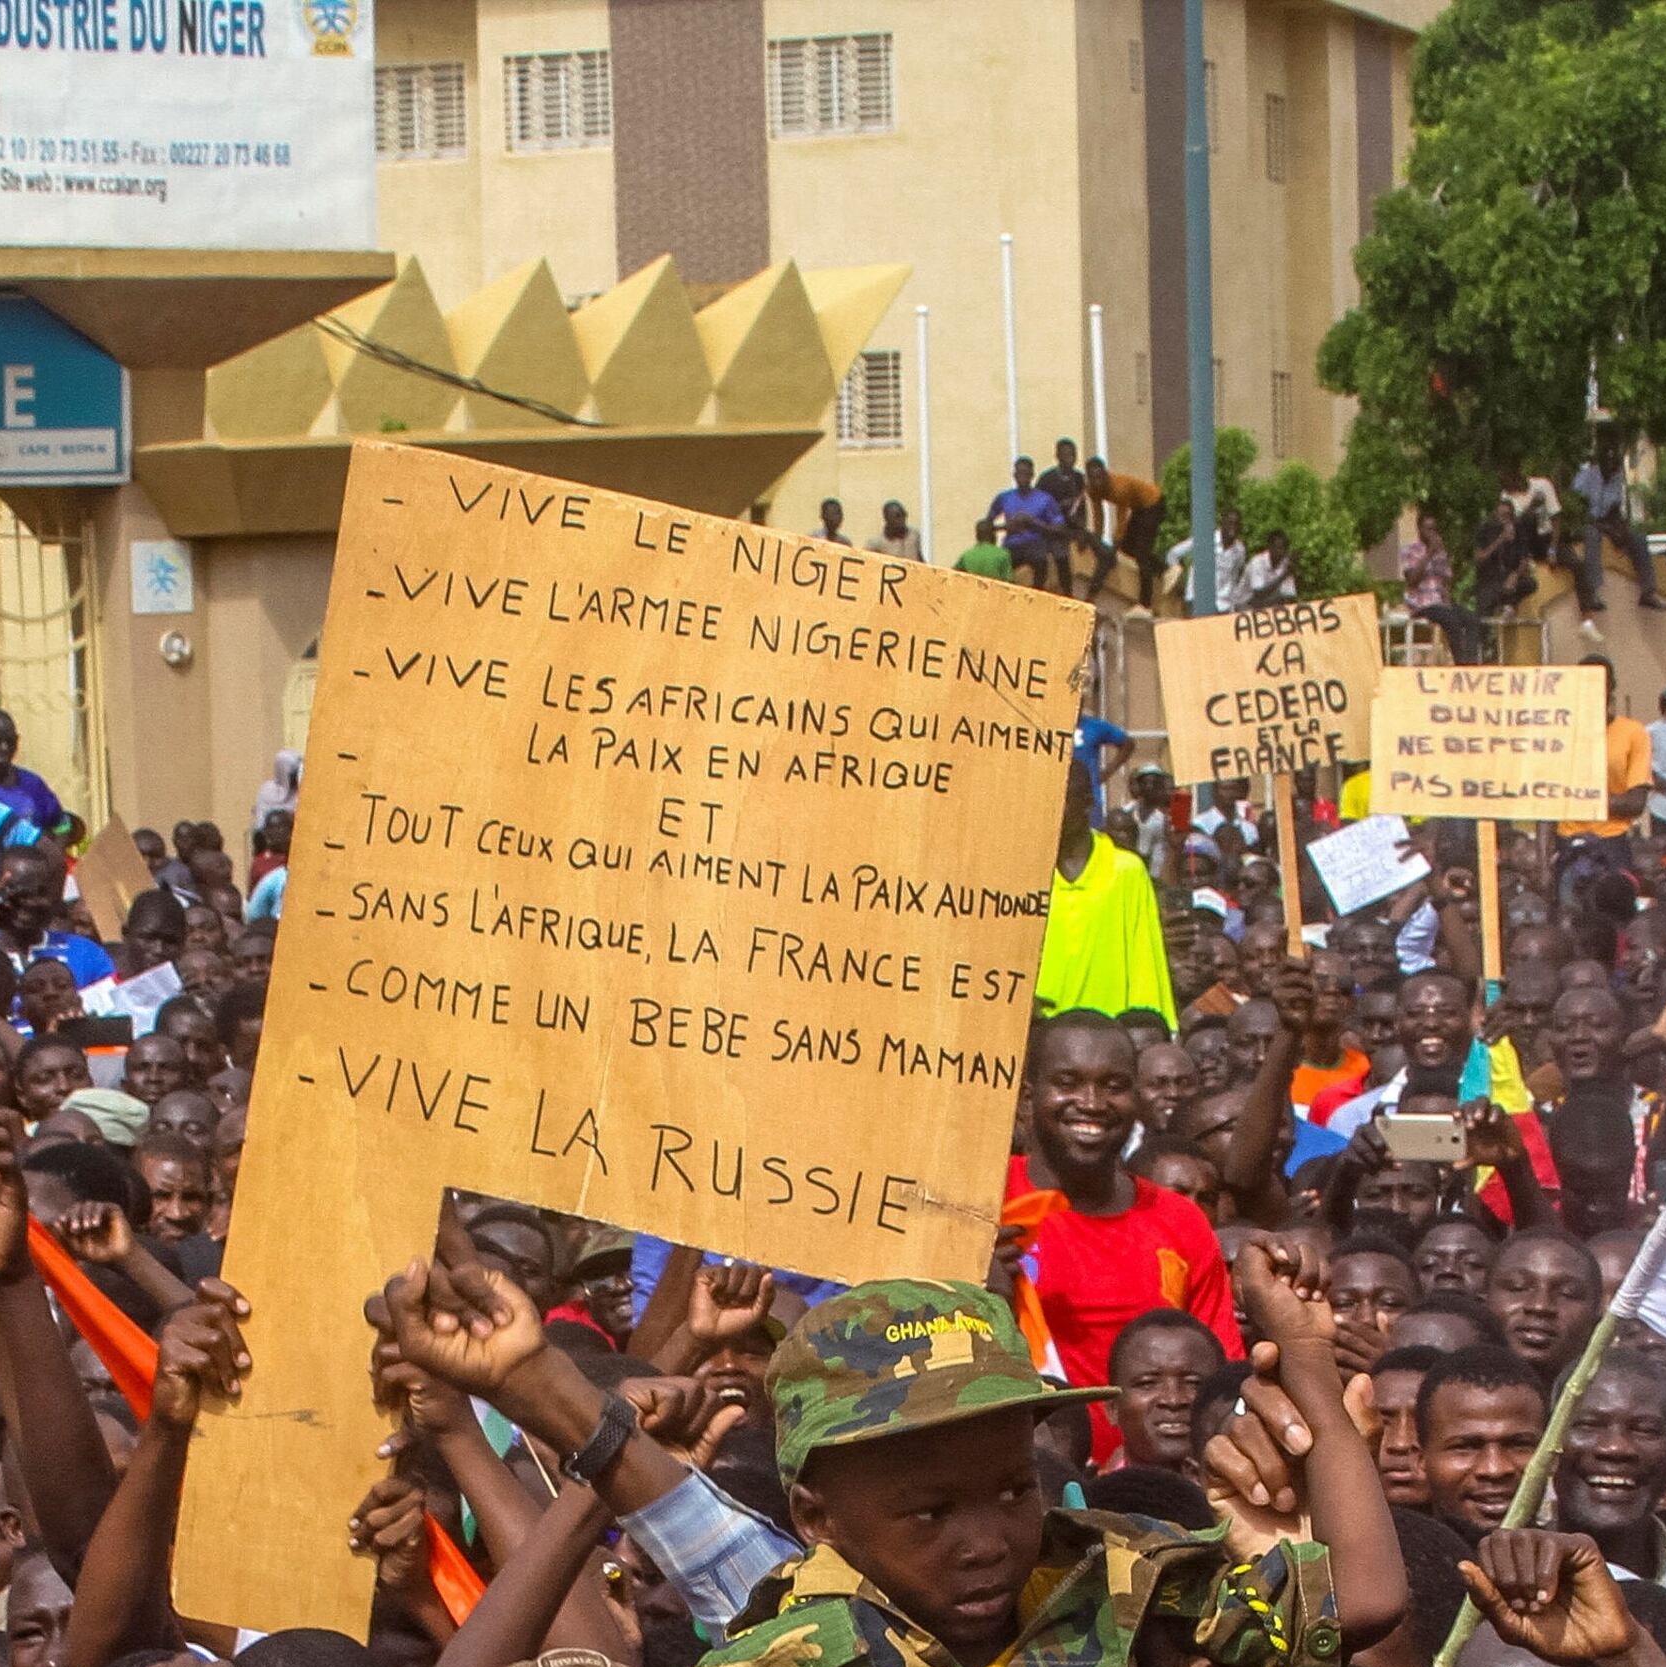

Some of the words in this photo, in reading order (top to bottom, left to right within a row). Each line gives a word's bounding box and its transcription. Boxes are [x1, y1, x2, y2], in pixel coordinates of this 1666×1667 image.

[130, 0, 166, 51] DU
[179, 0, 266, 58] NIGER
[39, 138, 56, 161] 20
[60, 139, 78, 162] 73
[234, 142, 251, 166] 73
[449, 475, 591, 531] VIVE
[634, 511, 692, 555] LE
[732, 535, 908, 608] NIGER
[548, 580, 723, 641] L'ARMEE
[749, 614, 1049, 700] NIGERIENNE
[1234, 601, 1341, 642] ABBAS
[542, 664, 617, 714] LES
[626, 684, 852, 738] AFRICAINS
[869, 706, 939, 742] QUI
[950, 714, 1073, 763] AIMENT
[1206, 679, 1348, 727] CEDEAO
[1257, 724, 1282, 745] ET
[1293, 718, 1321, 737] LA
[528, 722, 569, 766] LA
[590, 726, 683, 775] PAIX
[708, 744, 761, 780] EN
[784, 751, 953, 793] AFRIQUE
[1397, 735, 1435, 756] NE
[1443, 736, 1565, 755] DEPEND
[1389, 770, 1453, 799] PAS
[658, 797, 724, 845] ET
[361, 792, 464, 848] TOUT
[477, 819, 554, 863] CEUX
[568, 837, 633, 871] QUI
[649, 849, 787, 897] AIMENT
[801, 863, 840, 904] LA
[852, 864, 929, 915] PAIX
[934, 882, 975, 919] AU
[979, 887, 1052, 920] MONDE
[348, 882, 450, 928] SANS
[470, 883, 652, 965] L'AFRIQUE,
[667, 922, 720, 964] LA
[747, 926, 921, 992] FRANCE
[950, 962, 1027, 1005] EST
[346, 959, 511, 1025] COMME
[535, 989, 591, 1034] UN
[629, 998, 750, 1059] BEBE
[771, 1018, 862, 1065] SANS
[878, 1033, 1016, 1090] MAMAN
[338, 1046, 492, 1133] VIVE
[531, 1087, 609, 1177] LA
[650, 1123, 918, 1235] RUSSIE
[885, 1314, 952, 1343] GHANA
